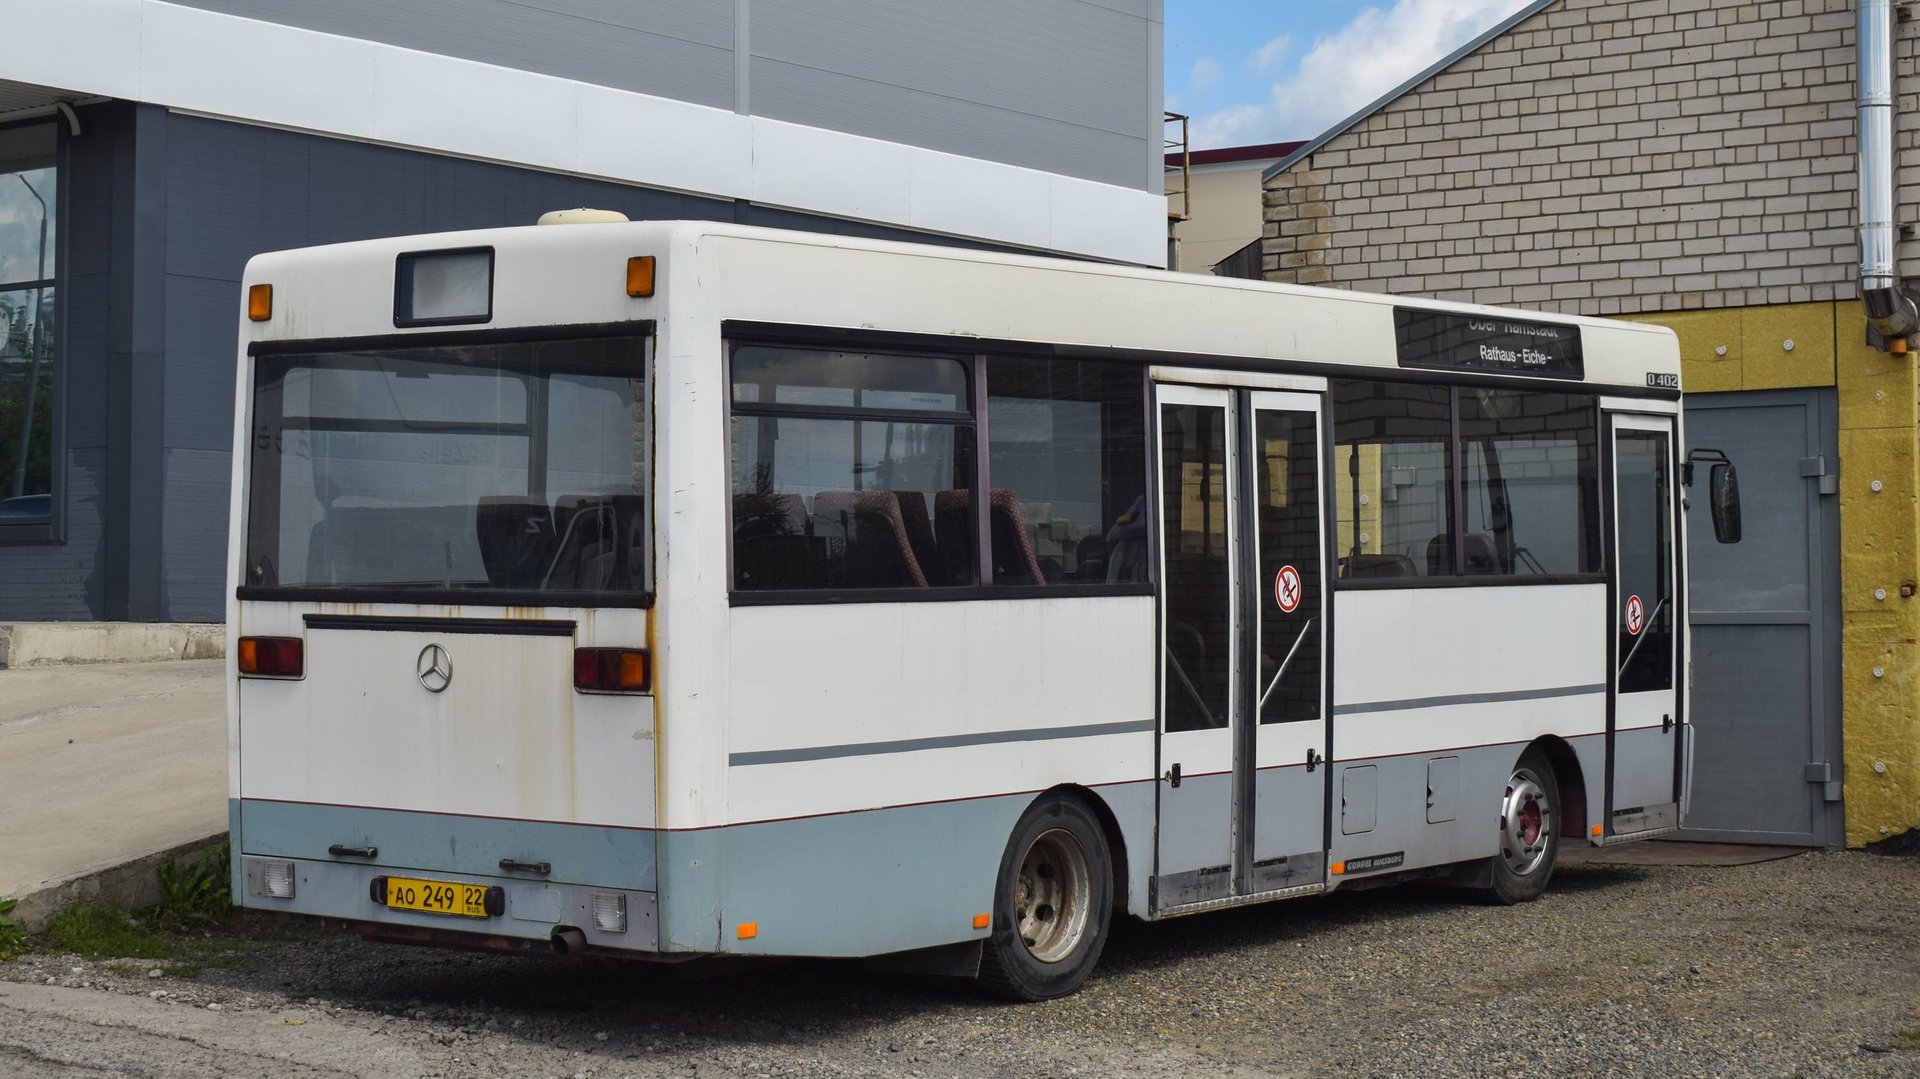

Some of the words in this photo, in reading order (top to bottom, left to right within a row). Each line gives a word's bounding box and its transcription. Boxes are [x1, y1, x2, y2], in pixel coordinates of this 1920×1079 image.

[1656, 374, 1678, 387] 402
[423, 884, 455, 909] 249
[465, 887, 482, 906] 22
[466, 905, 480, 914] RUS
